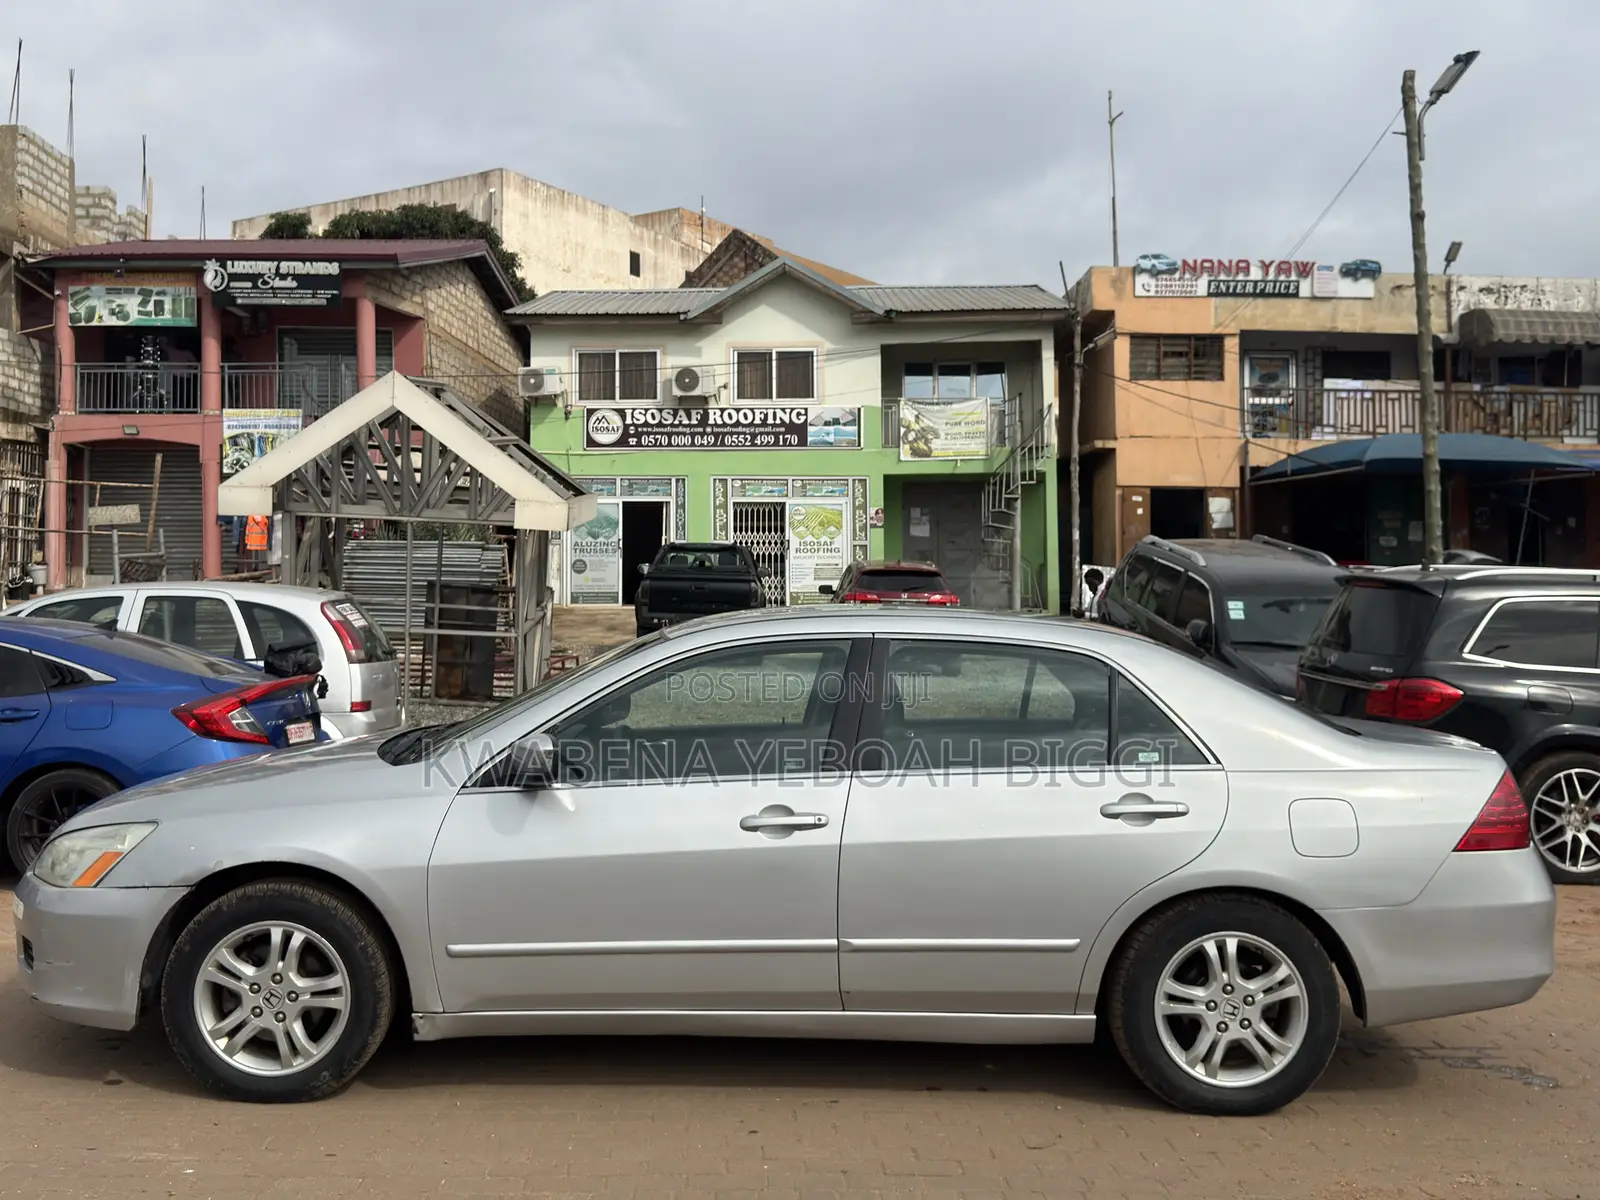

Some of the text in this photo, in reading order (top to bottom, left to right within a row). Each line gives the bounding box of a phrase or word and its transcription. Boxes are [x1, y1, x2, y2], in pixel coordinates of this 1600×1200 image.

[226, 260, 340, 275] LUXURY STRANDS
[1181, 258, 1316, 279] NANA YAW
[624, 408, 807, 425] ISOSAF ROOFING
[641, 434, 668, 446] 0570
[671, 434, 692, 446] 000
[694, 434, 715, 446] 049
[724, 434, 751, 446] 0552
[754, 434, 775, 446] 499
[778, 434, 798, 446] 170
